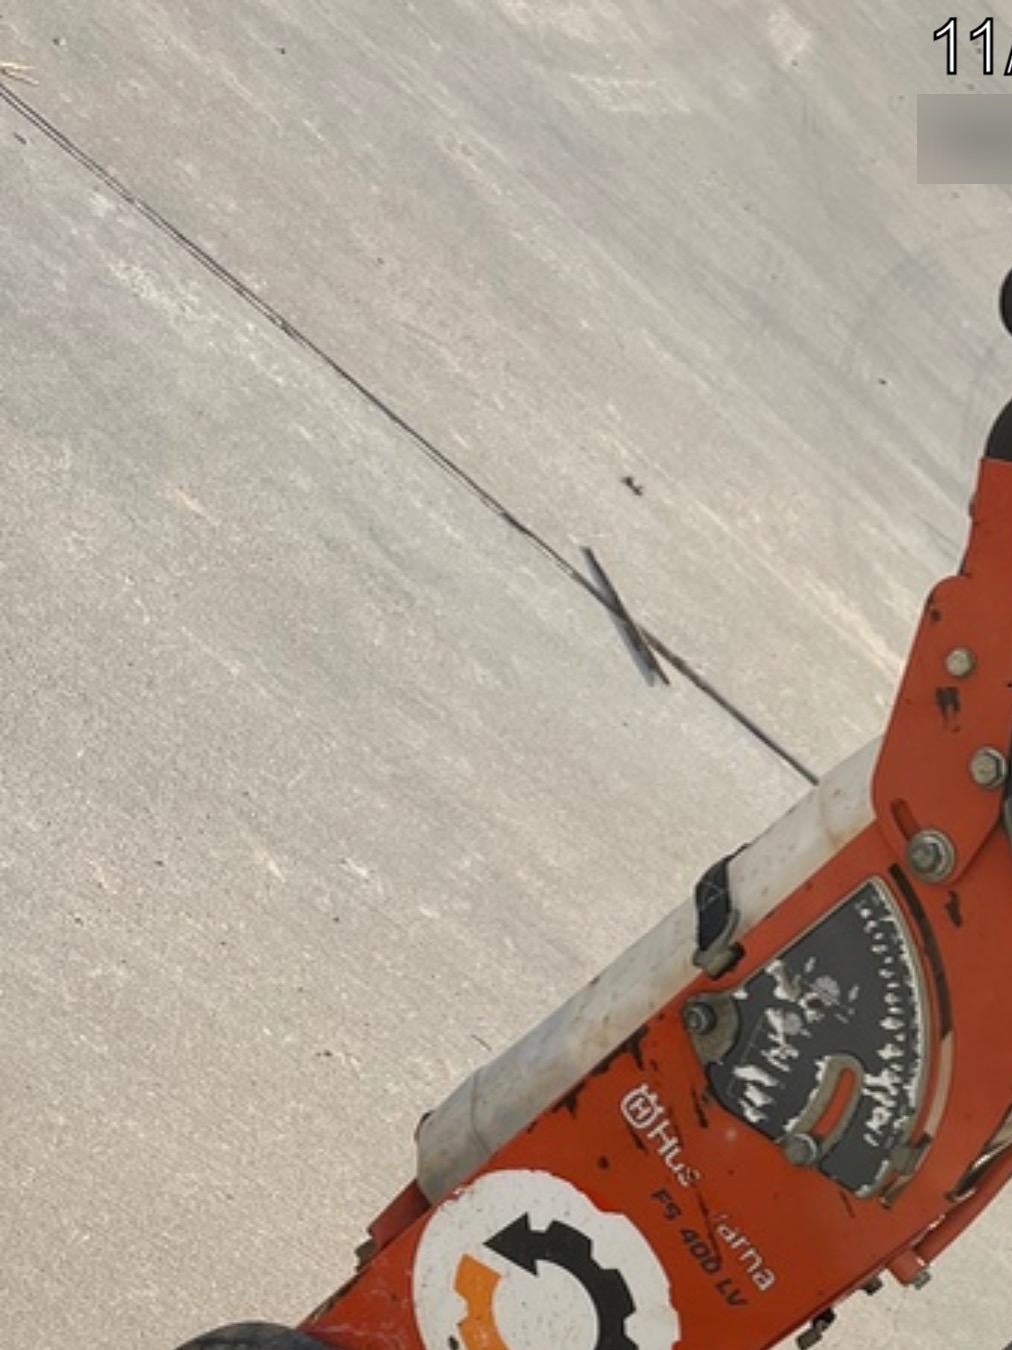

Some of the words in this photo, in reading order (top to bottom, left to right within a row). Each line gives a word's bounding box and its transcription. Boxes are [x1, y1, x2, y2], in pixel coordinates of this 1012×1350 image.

[647, 1119, 775, 1292] Husarna
[654, 1188, 682, 1221] FS
[680, 1228, 722, 1275] 400
